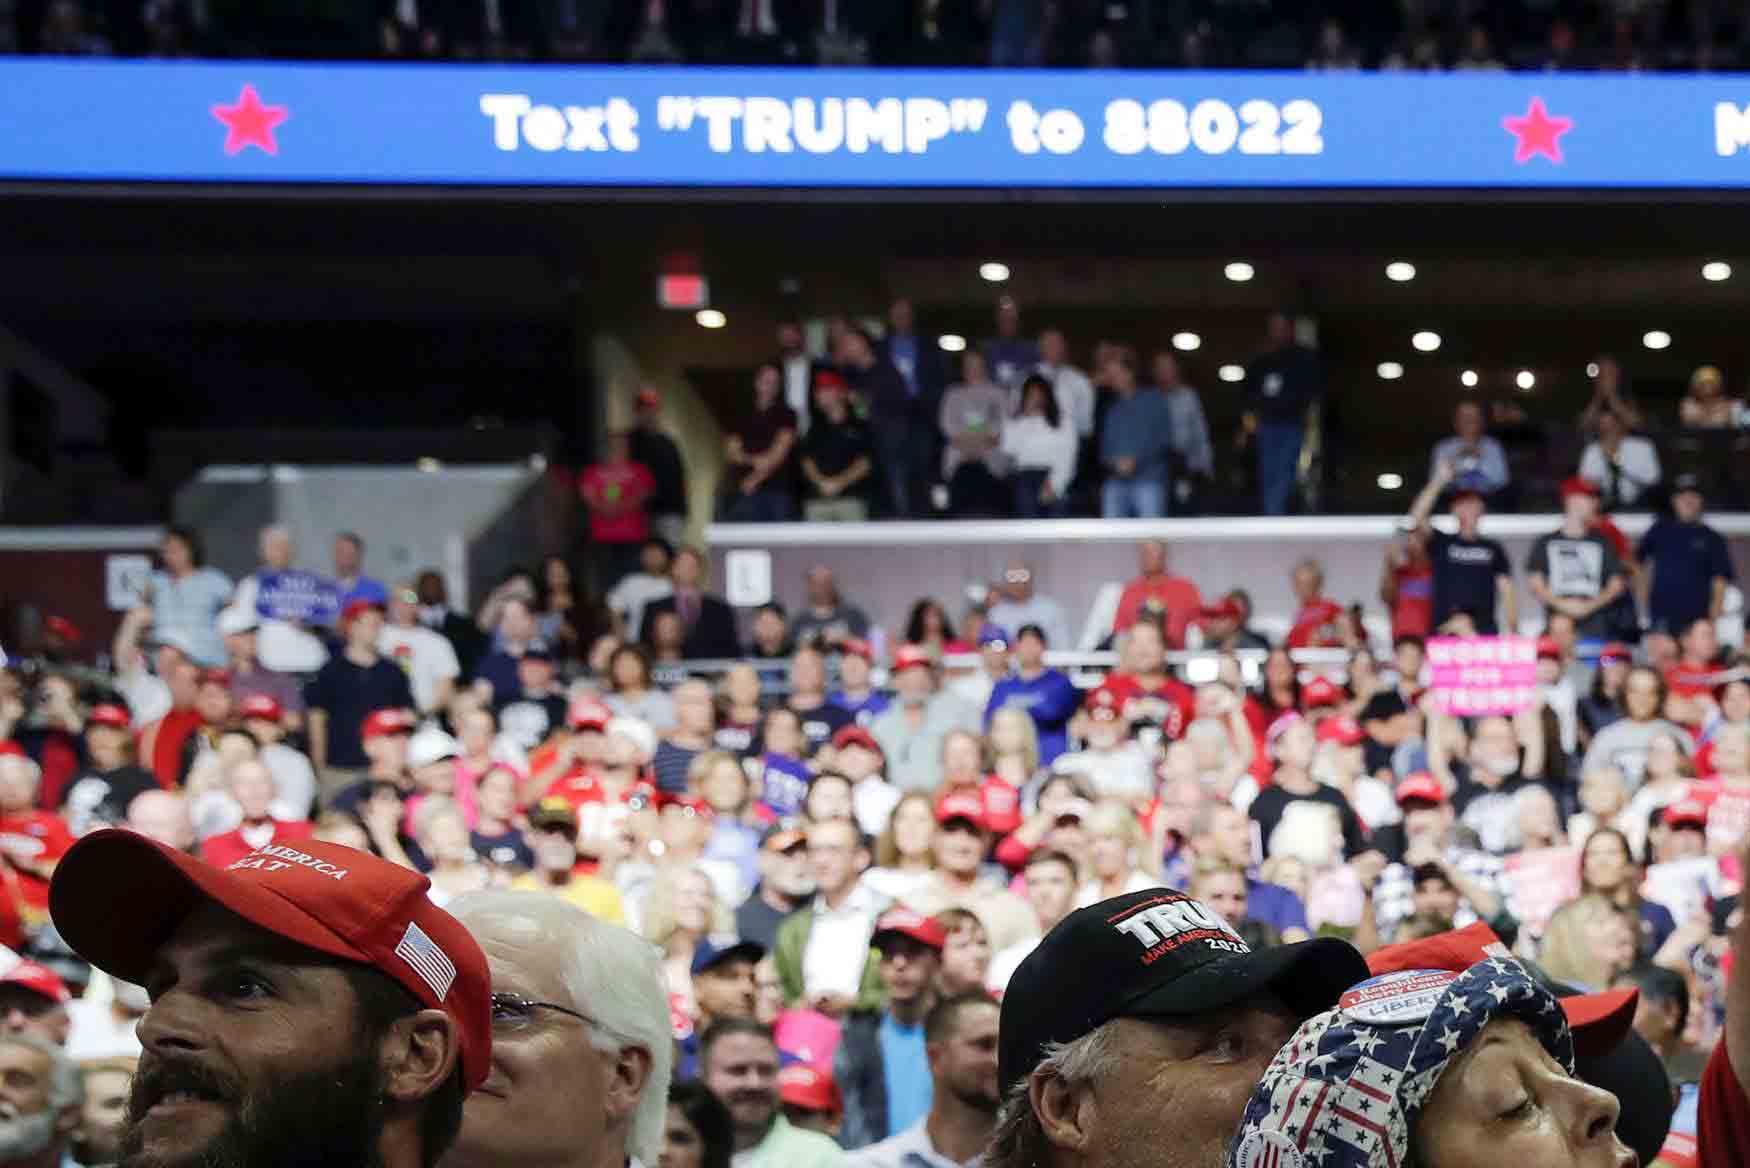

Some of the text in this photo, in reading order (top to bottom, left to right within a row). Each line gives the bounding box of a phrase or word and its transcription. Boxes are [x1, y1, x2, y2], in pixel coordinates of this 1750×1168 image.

[479, 94, 1323, 155] Text "TRUMP" to 88022
[1114, 899, 1248, 949] TRU
[1204, 937, 1251, 954] 2020
